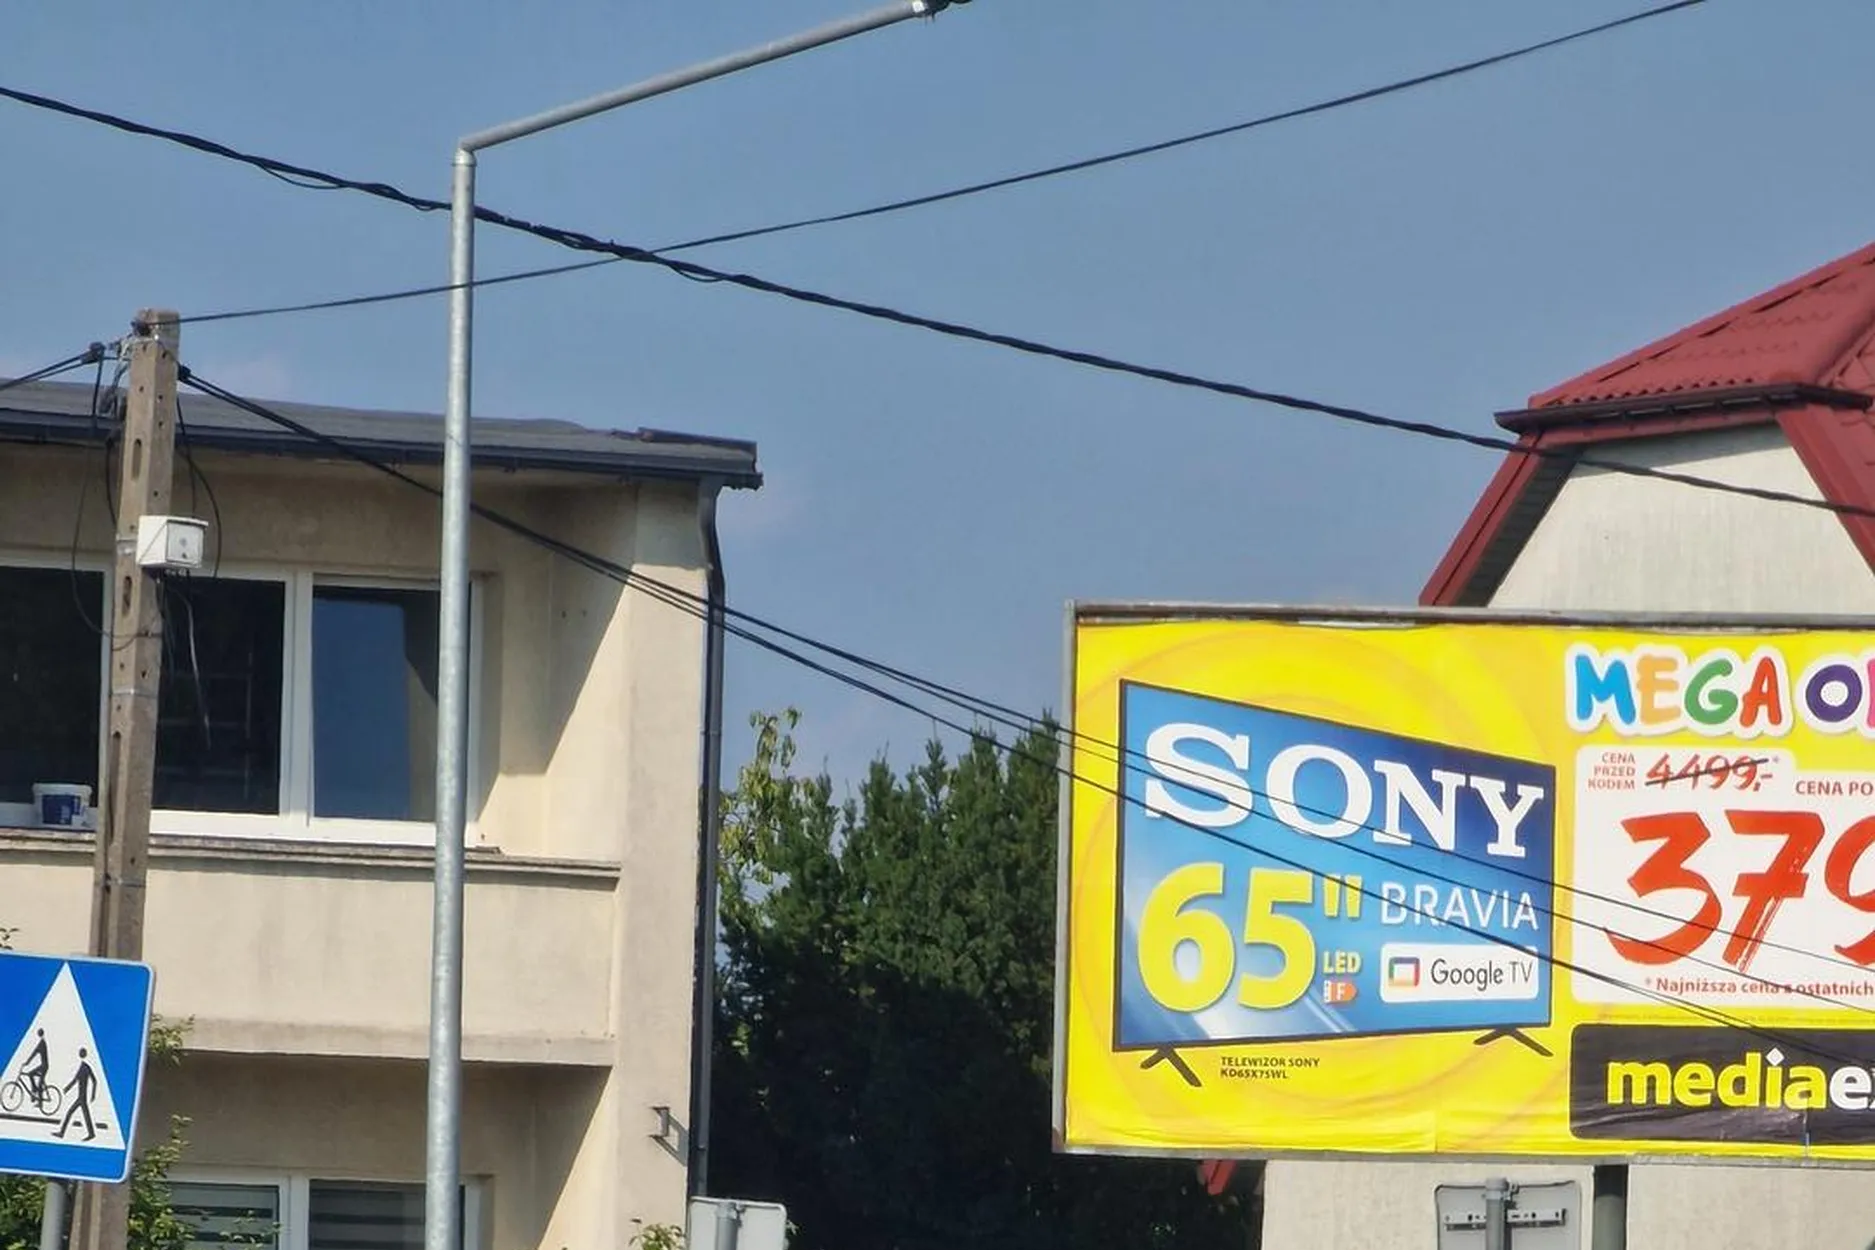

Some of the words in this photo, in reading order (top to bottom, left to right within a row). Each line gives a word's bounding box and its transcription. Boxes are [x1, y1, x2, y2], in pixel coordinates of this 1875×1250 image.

[1574, 653, 1783, 728] MEGA
[1805, 656, 1875, 728] O
[1601, 752, 1636, 764] CENA
[1593, 765, 1636, 777] PRZED
[1144, 722, 1545, 858] SONY
[1587, 778, 1636, 790] KODEM
[1795, 780, 1843, 796] CENA
[1849, 781, 1874, 796] PO
[1380, 881, 1539, 931] BRAVIA
[1323, 950, 1361, 974] LED
[1430, 958, 1504, 992] Google
[1508, 961, 1534, 983] TV
[1656, 977, 1737, 996] Najniższa
[1741, 982, 1780, 994] cena
[1796, 980, 1874, 997] ostatnich
[1221, 1056, 1286, 1067] TELEWIZOR
[1288, 1057, 1320, 1068] SONY
[1606, 1047, 1875, 1111] mediae
